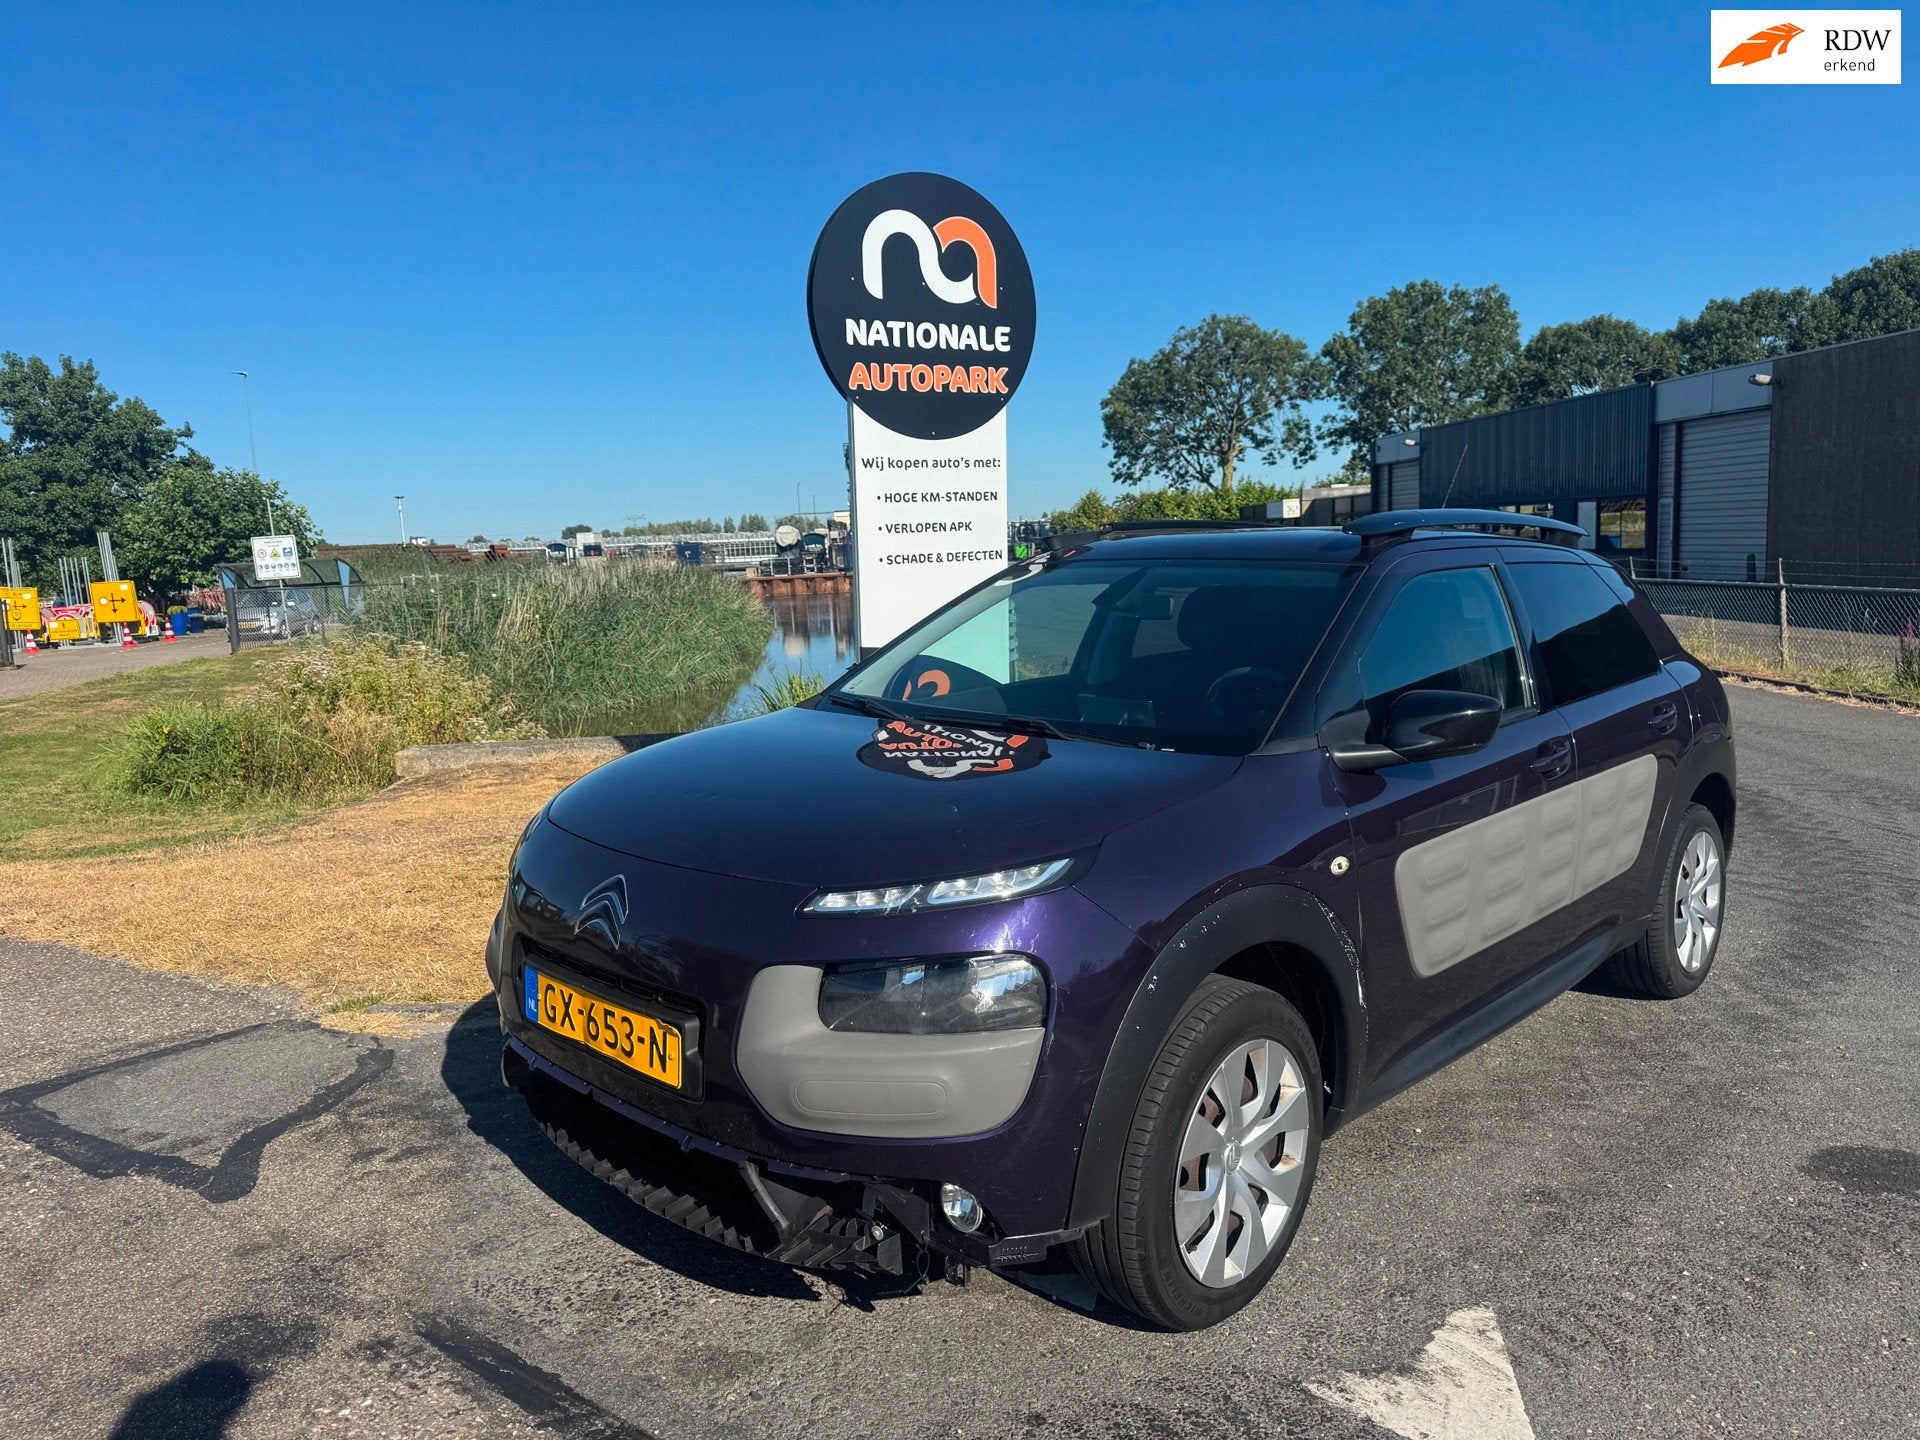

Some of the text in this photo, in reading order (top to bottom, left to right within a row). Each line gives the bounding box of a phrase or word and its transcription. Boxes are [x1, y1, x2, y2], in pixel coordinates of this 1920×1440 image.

[845, 318, 1011, 352] NATIONALE
[848, 362, 1009, 394] AUTOPARK
[861, 457, 1001, 471] Wij kopen auto's met:
[884, 491, 998, 503] HOGE KM-STANDEN
[886, 521, 972, 534] VERLOPEN APK
[886, 550, 1003, 565] SCHADE & DEFECTEN
[528, 997, 538, 1012] NL
[544, 983, 668, 1074] GX-653-N
